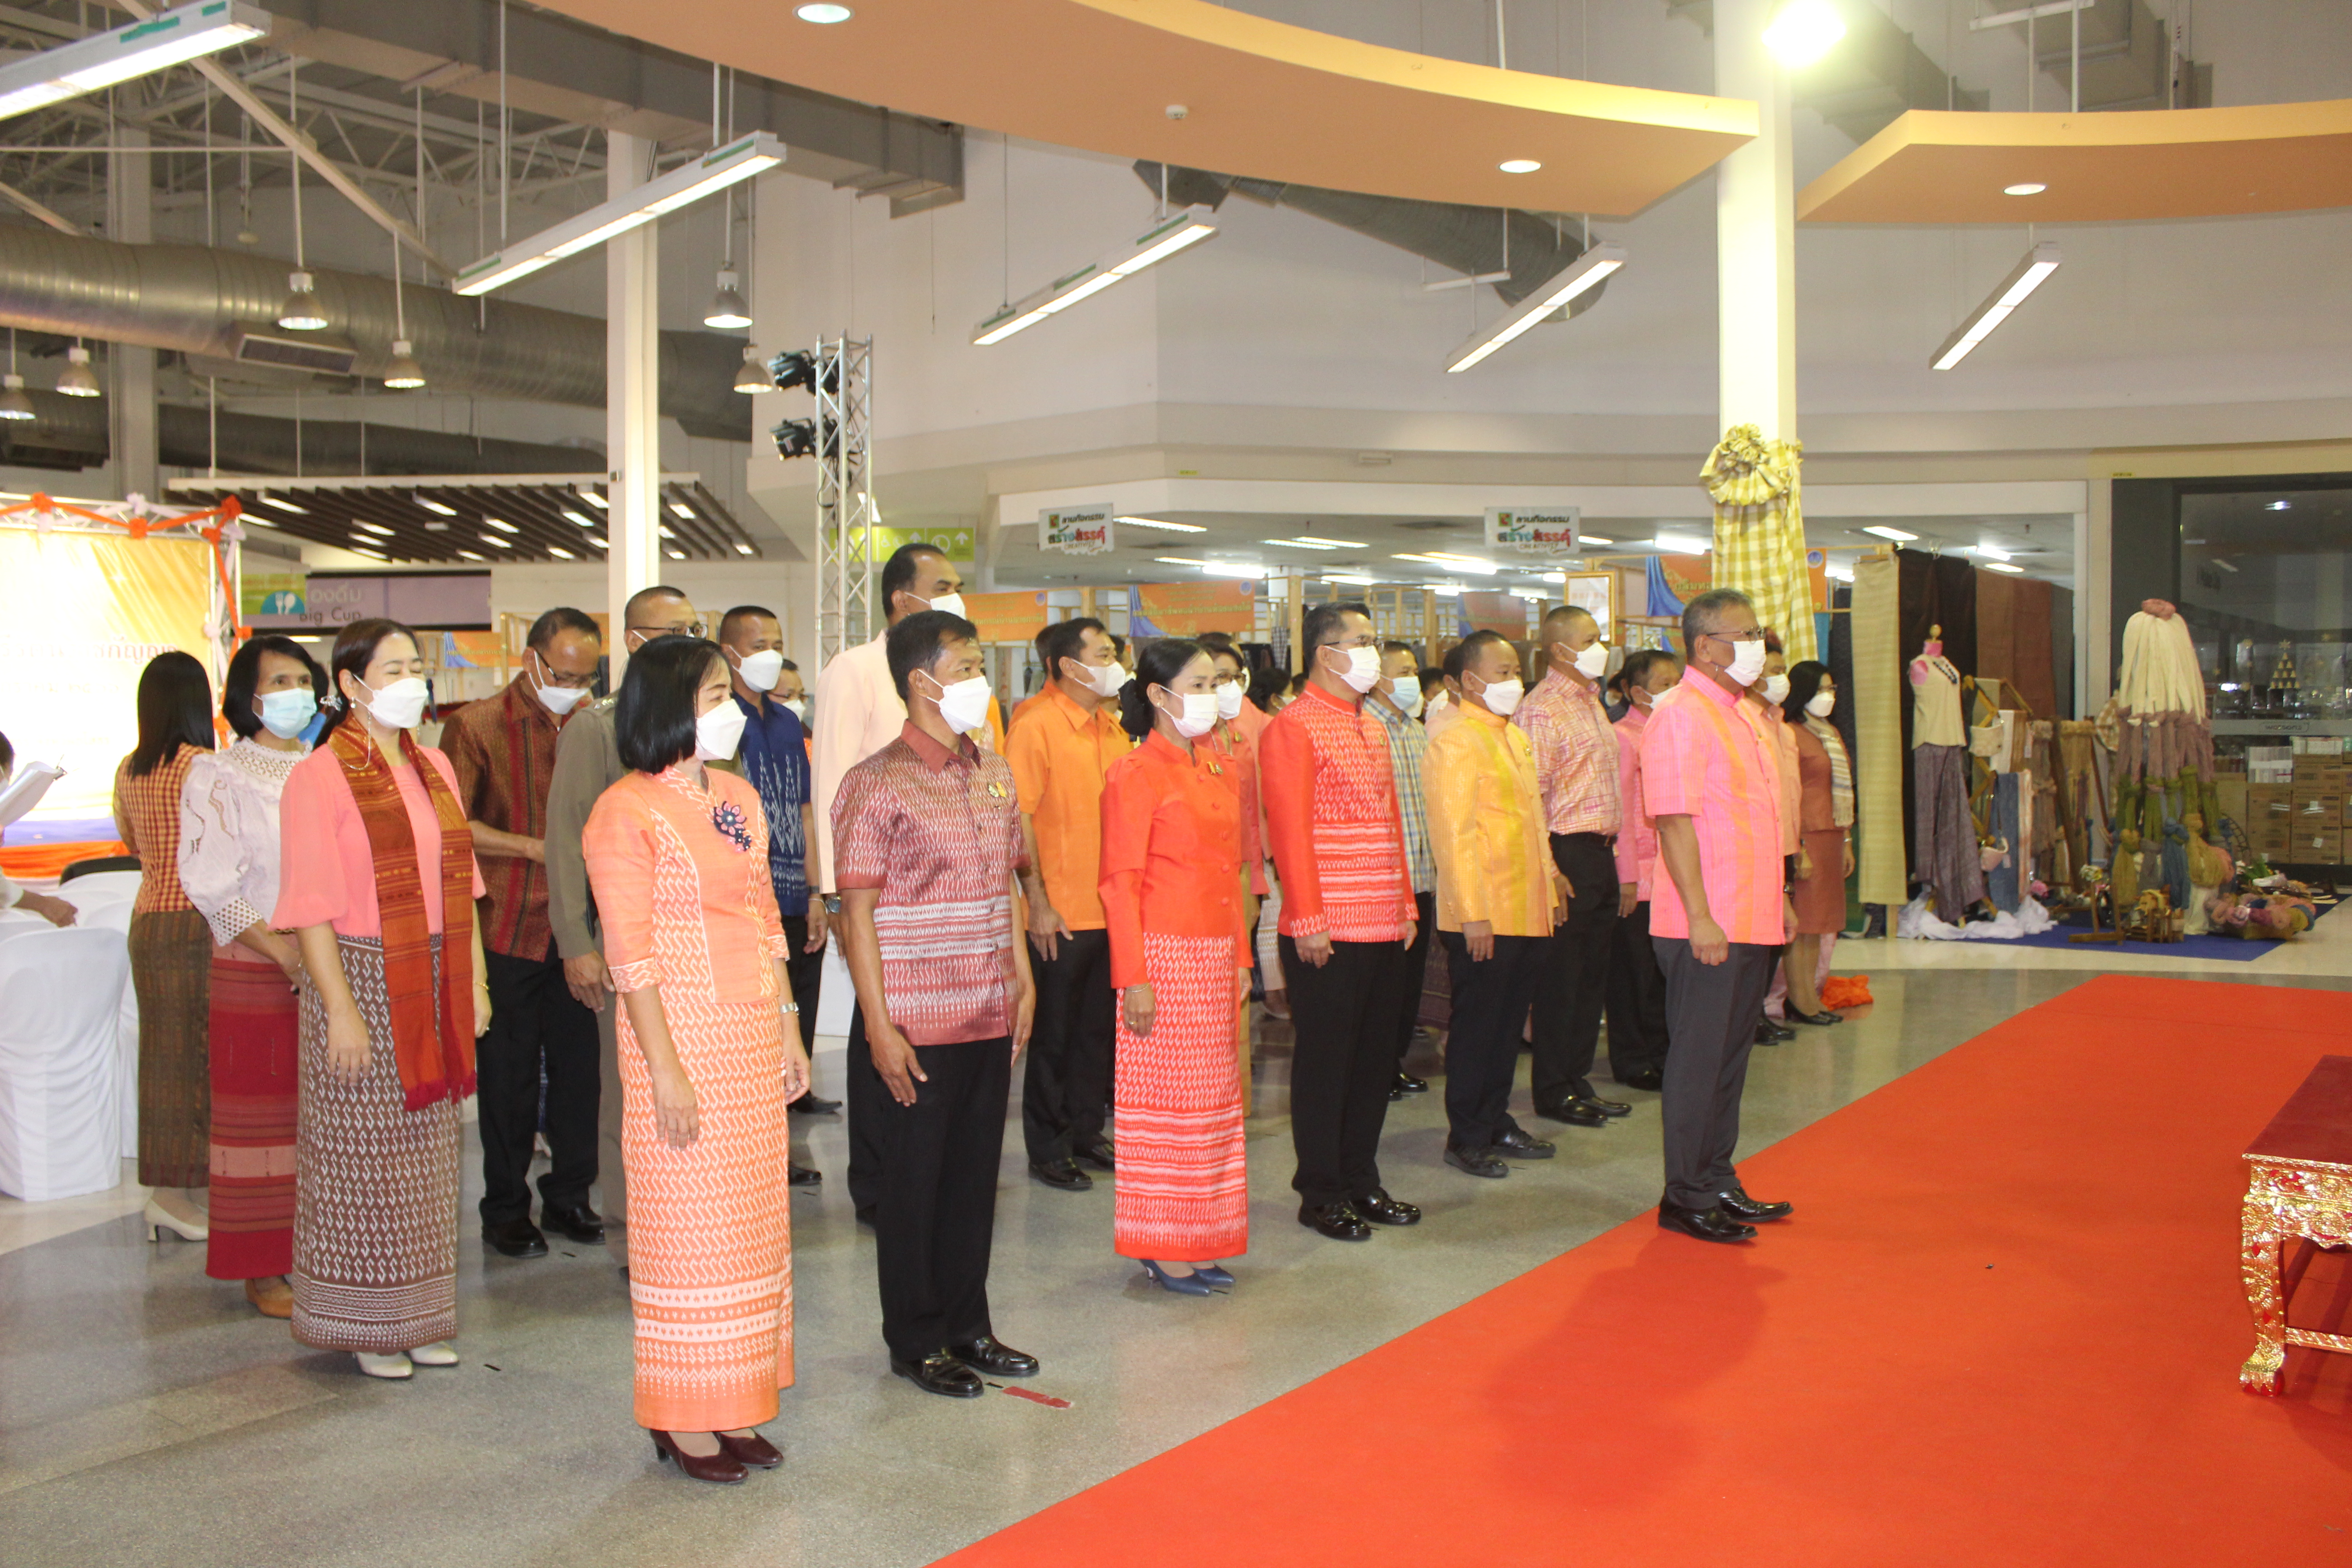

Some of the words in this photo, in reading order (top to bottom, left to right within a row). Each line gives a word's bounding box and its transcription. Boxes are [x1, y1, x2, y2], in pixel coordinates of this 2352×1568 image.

[1062, 513, 1105, 524] ลานกิจกรรม
[1516, 514, 1570, 524] ลานกิจกรรม
[1048, 524, 1106, 545] สร้างสรรค์
[1498, 524, 1571, 547] สร้างสรรค์
[331, 606, 361, 621] Cup
